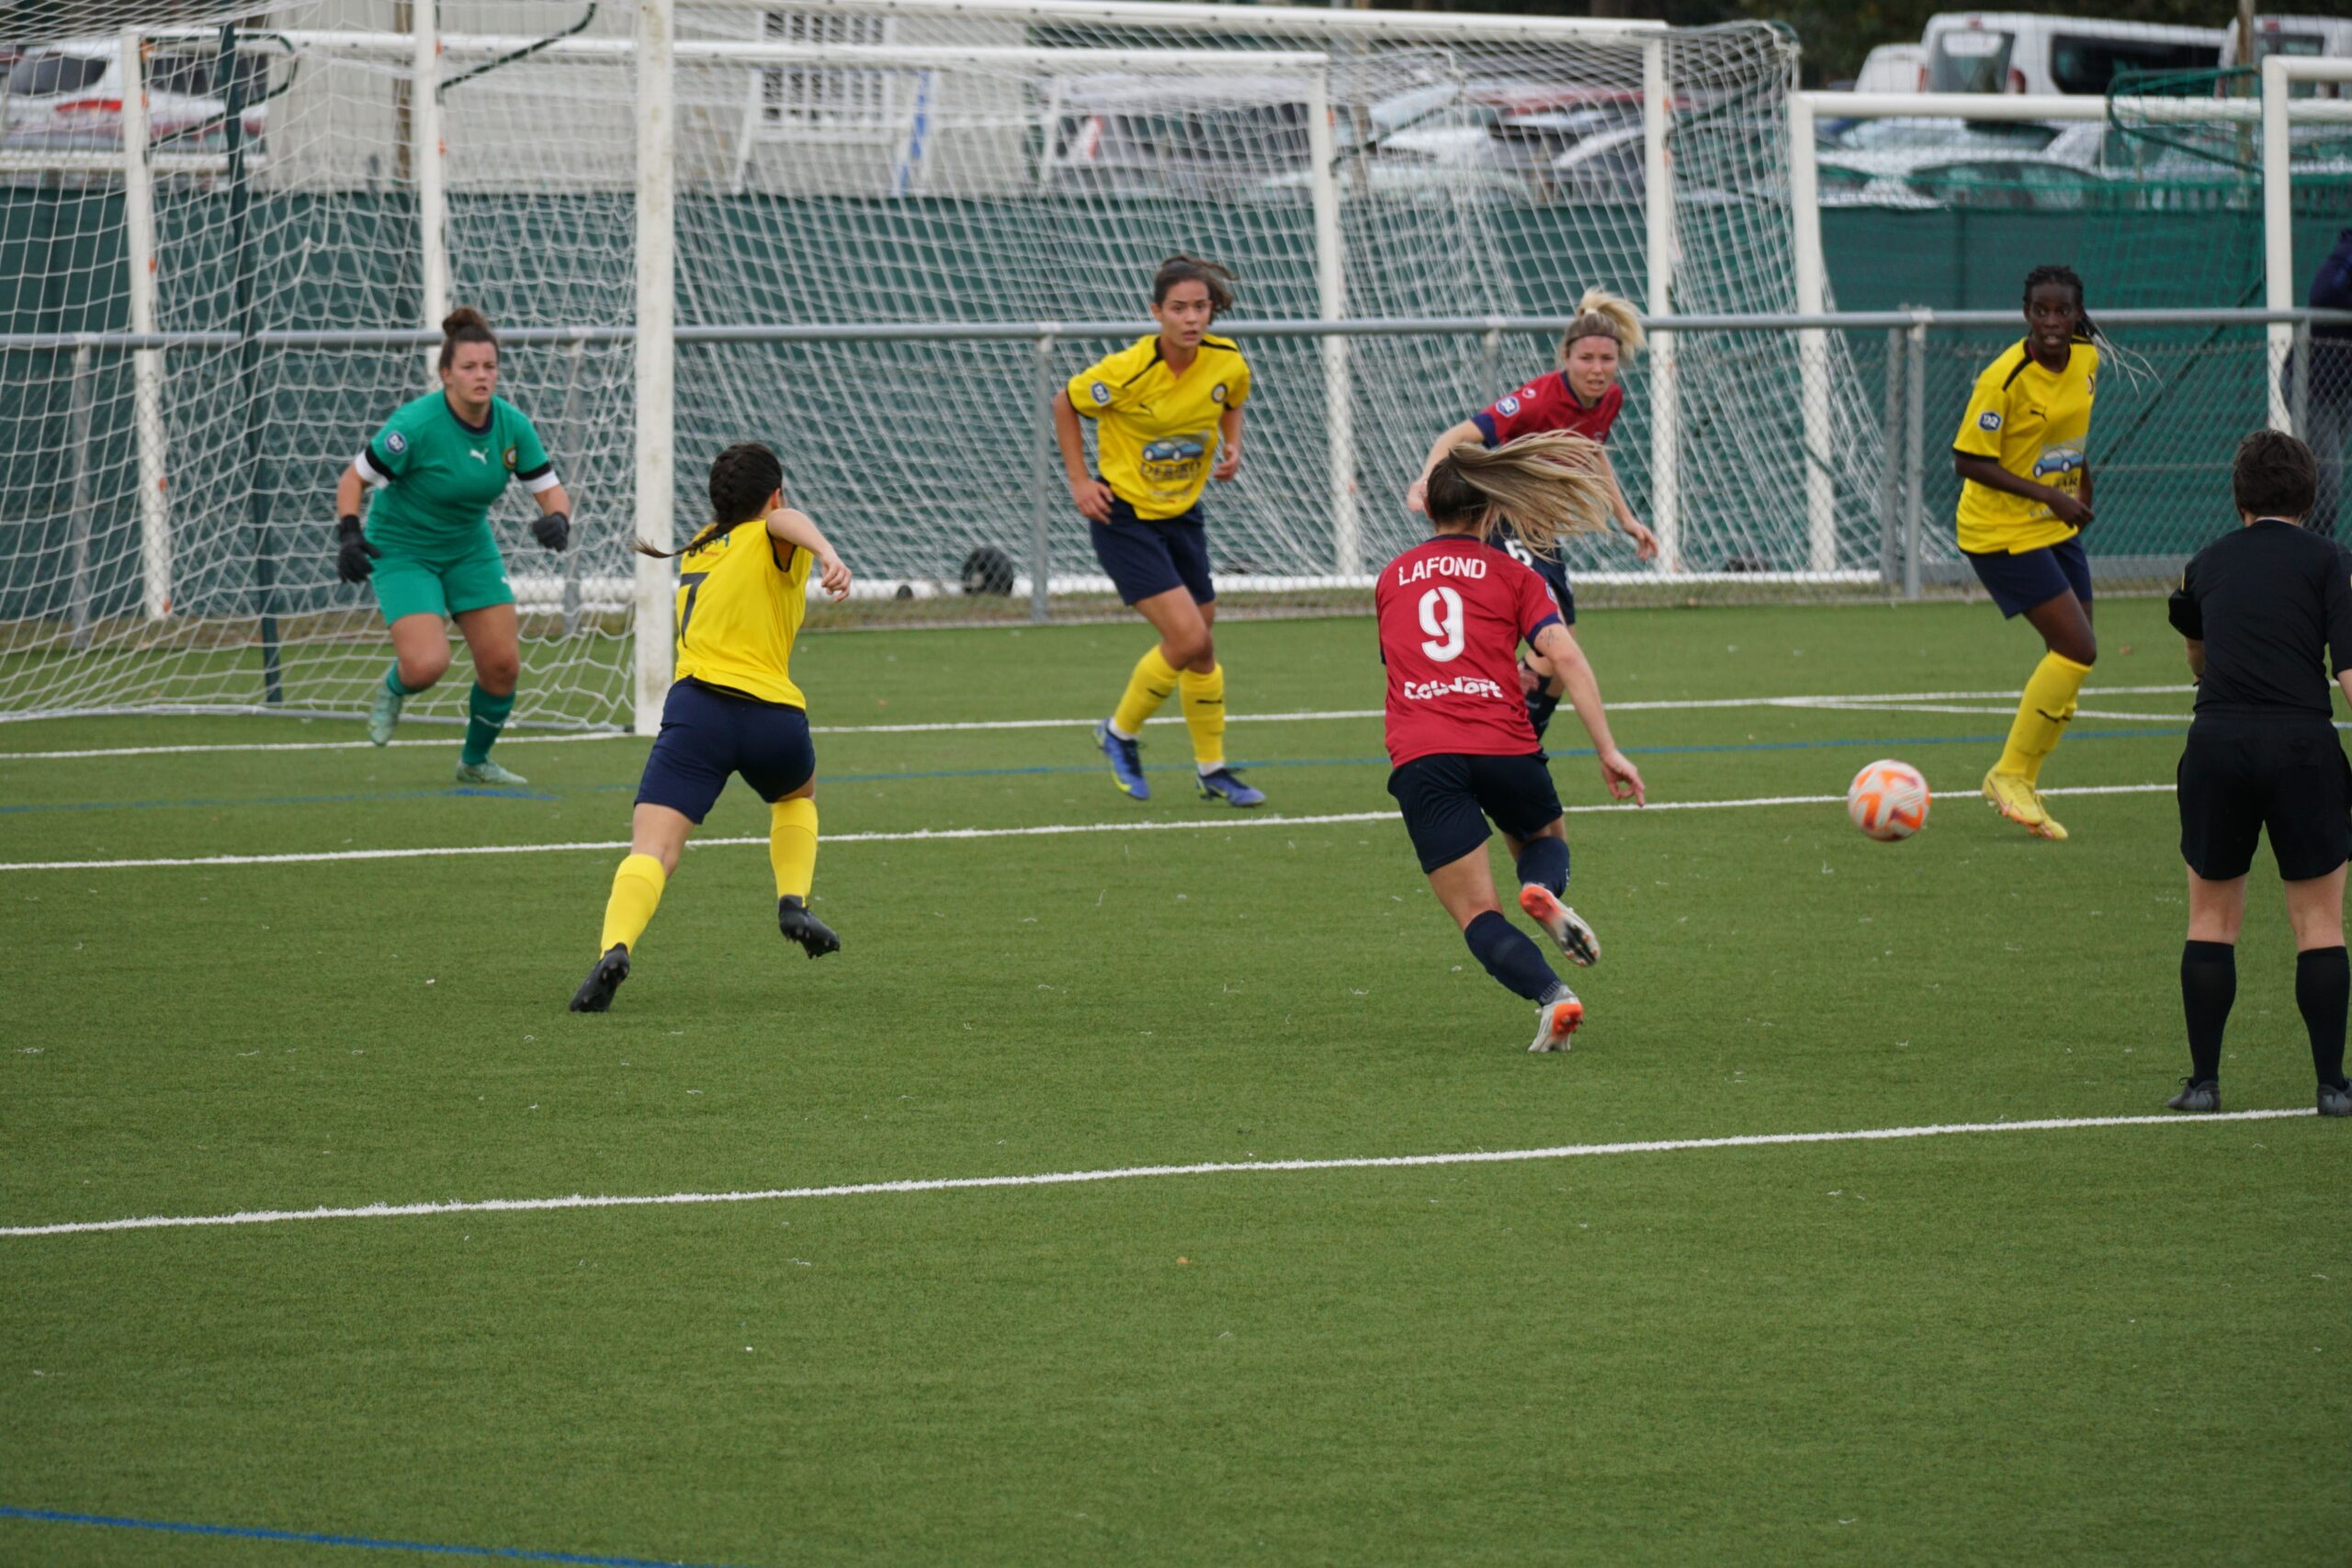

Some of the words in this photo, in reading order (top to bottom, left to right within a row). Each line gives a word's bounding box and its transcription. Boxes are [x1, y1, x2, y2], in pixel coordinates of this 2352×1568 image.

[1398, 556, 1487, 586] LAFOND
[679, 571, 711, 649] 7
[1418, 586, 1465, 662] 9
